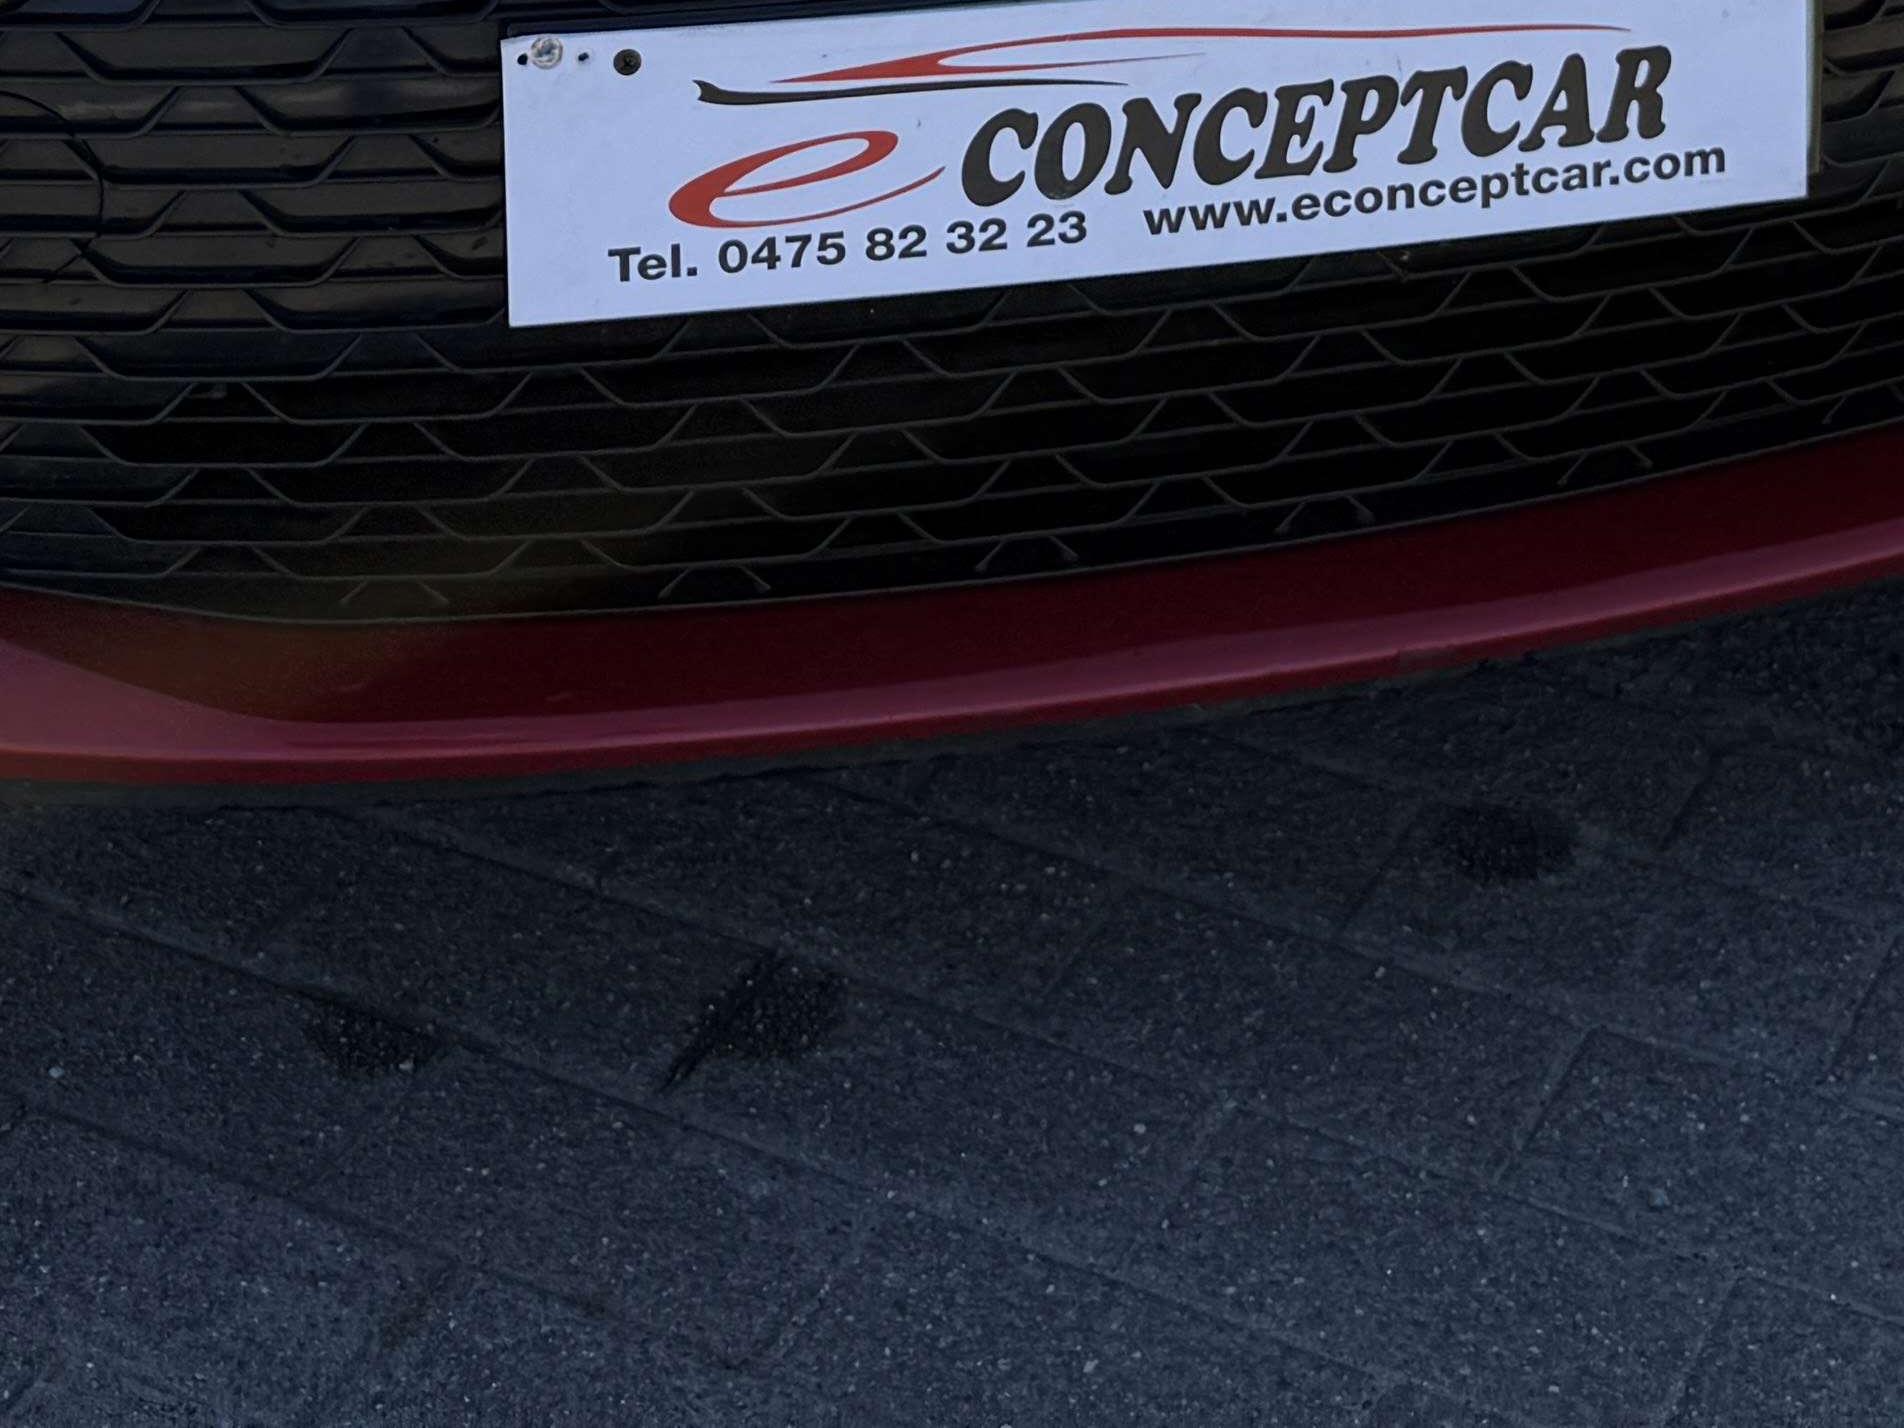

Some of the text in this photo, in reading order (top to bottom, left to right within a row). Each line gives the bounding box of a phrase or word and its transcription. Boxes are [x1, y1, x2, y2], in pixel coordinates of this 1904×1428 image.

[607, 140, 1728, 286] Tel. 0475 82 32 23 www.econceptcar.com
